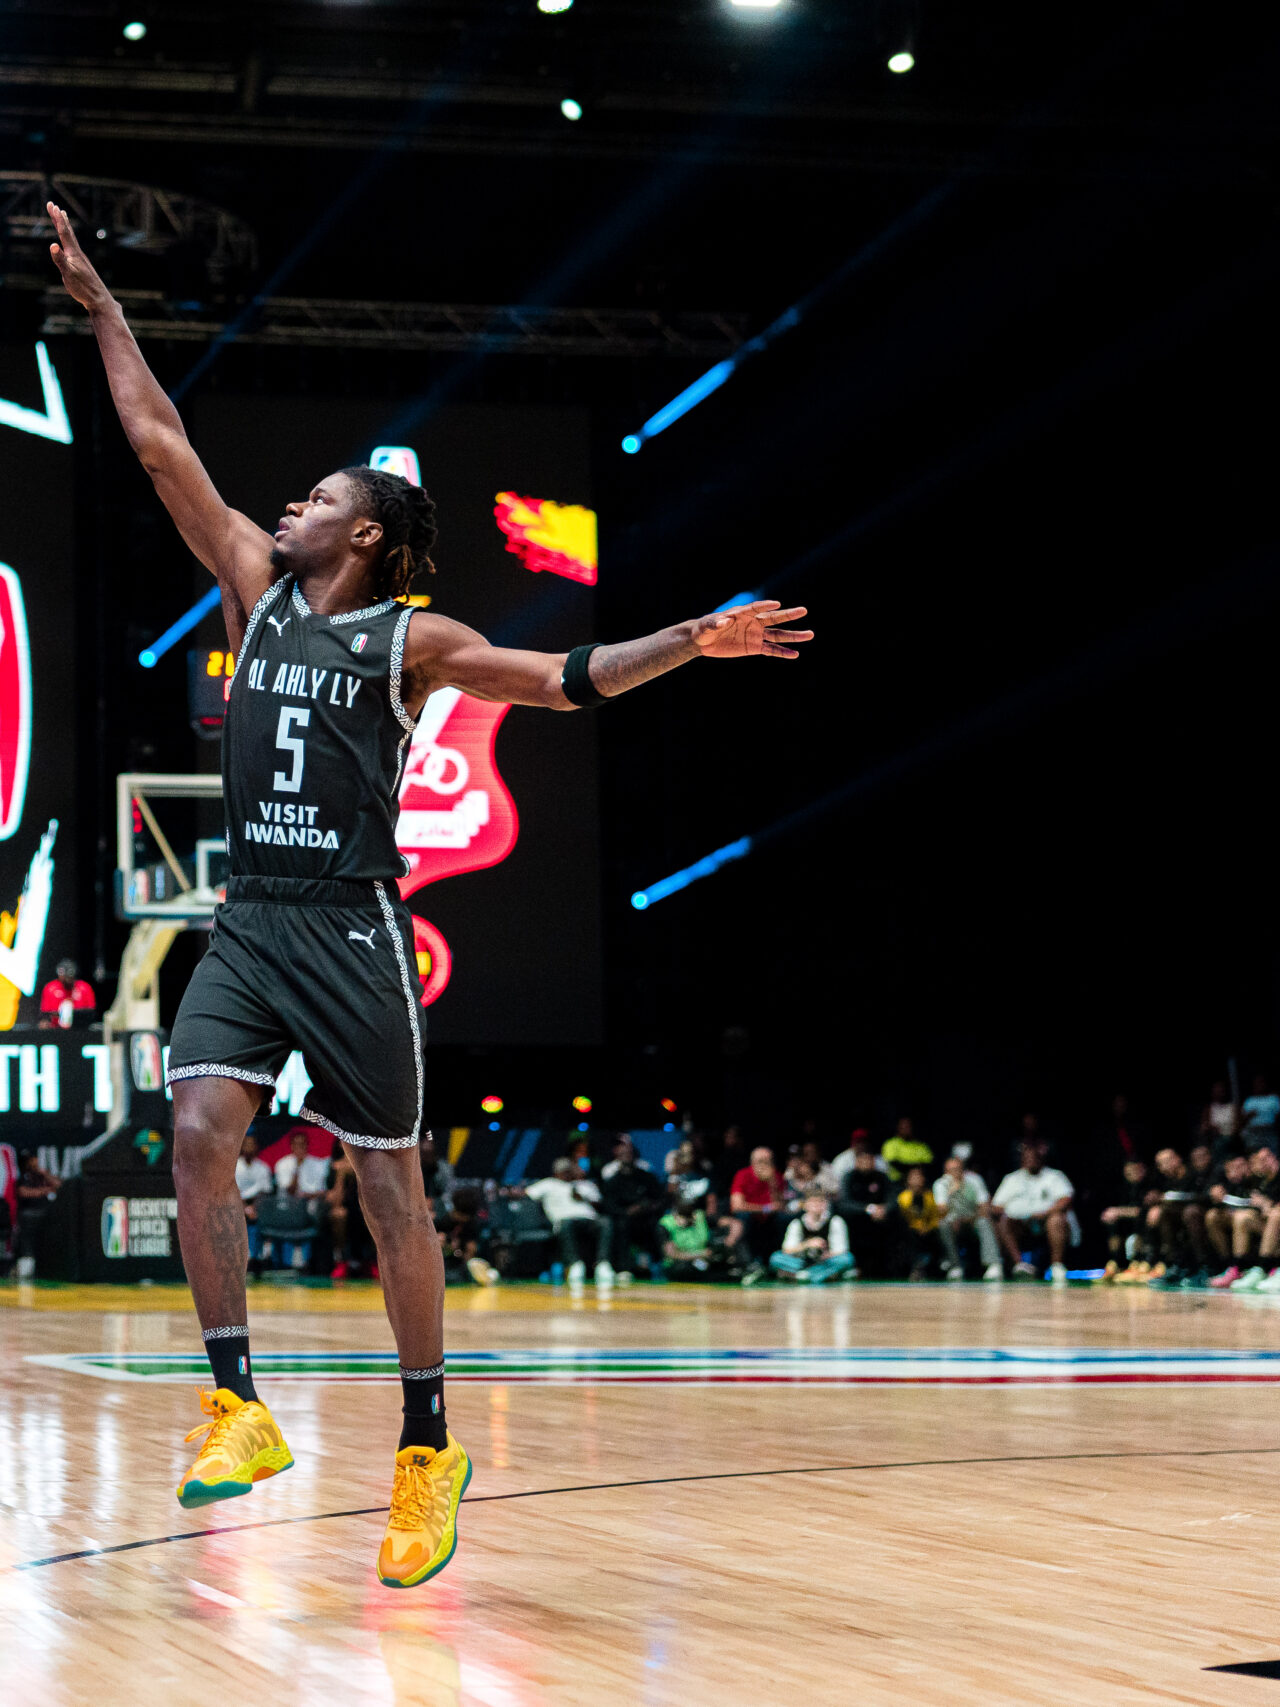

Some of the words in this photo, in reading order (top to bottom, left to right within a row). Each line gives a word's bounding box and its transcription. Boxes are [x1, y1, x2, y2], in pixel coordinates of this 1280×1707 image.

[248, 657, 268, 692] AL
[272, 662, 328, 700] AHLY
[329, 672, 362, 709] LY
[273, 705, 311, 793] 5
[258, 801, 320, 827] VISIT
